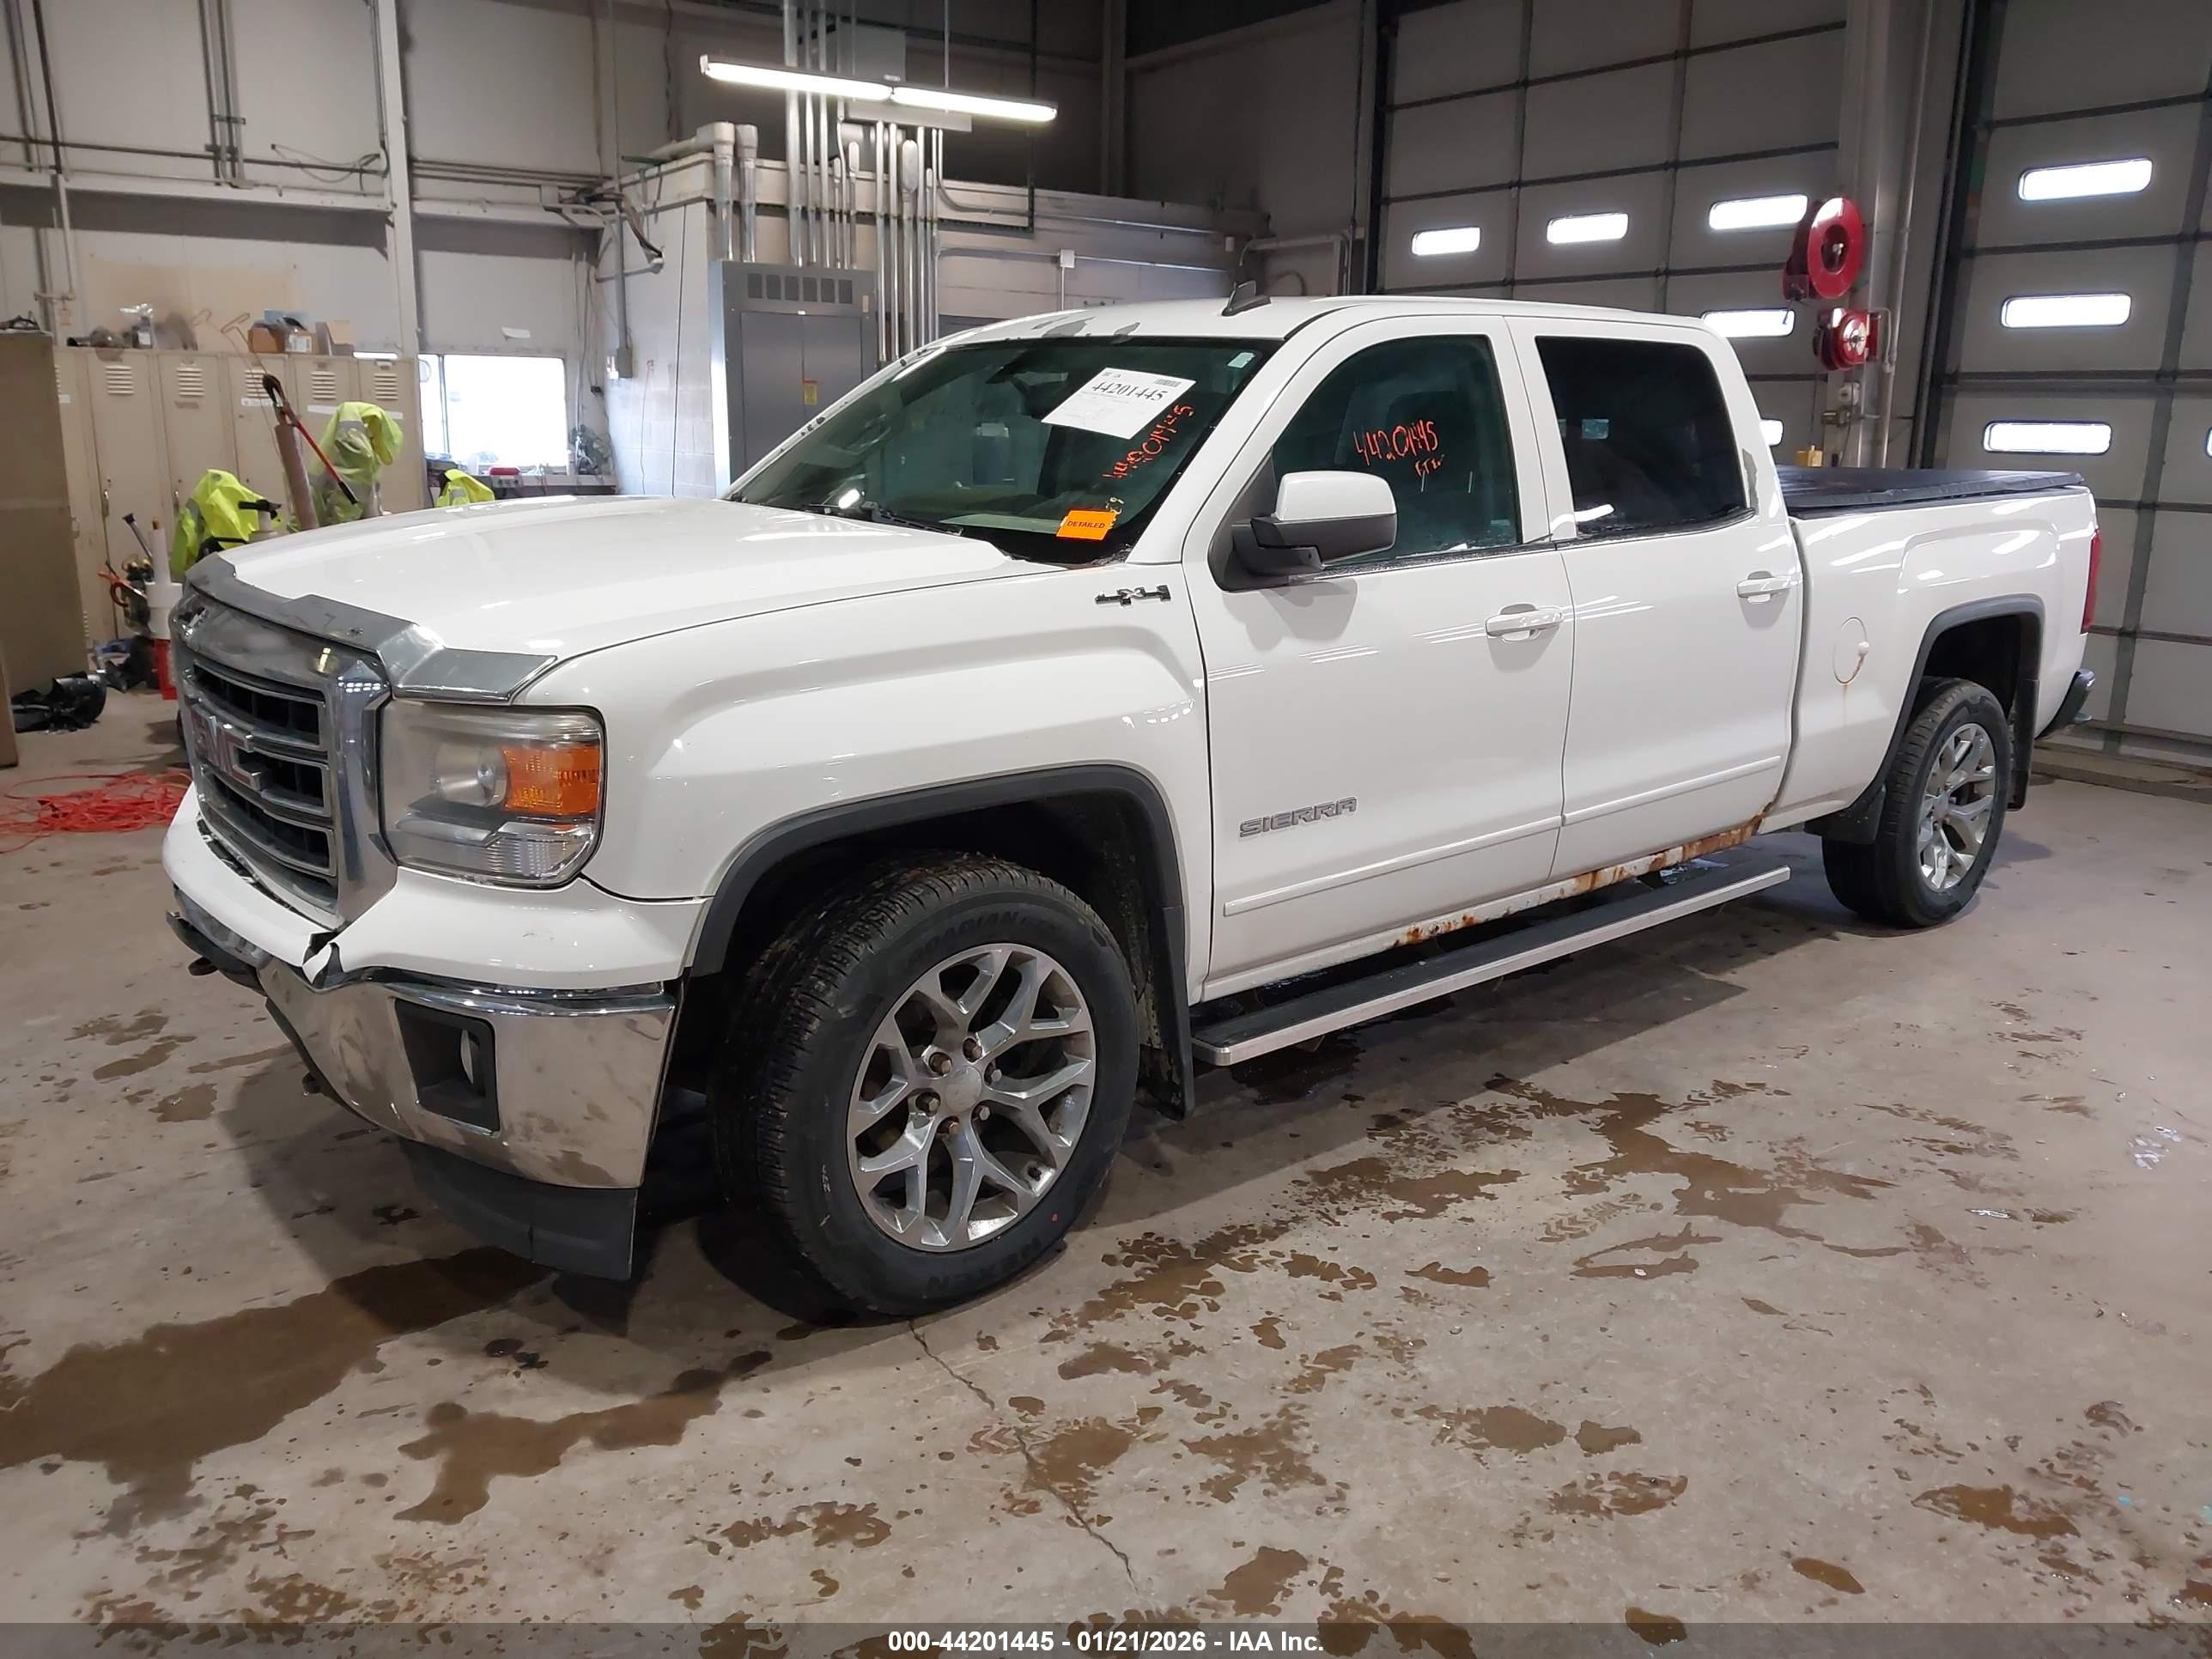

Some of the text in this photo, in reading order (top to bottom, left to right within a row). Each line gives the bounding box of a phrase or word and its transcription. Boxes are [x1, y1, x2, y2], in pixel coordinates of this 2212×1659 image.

[1091, 380, 1169, 401] 44201445
[1066, 520, 1106, 529] DETAILED
[190, 702, 261, 791] GMC
[1239, 796, 1358, 838] SIERRA
